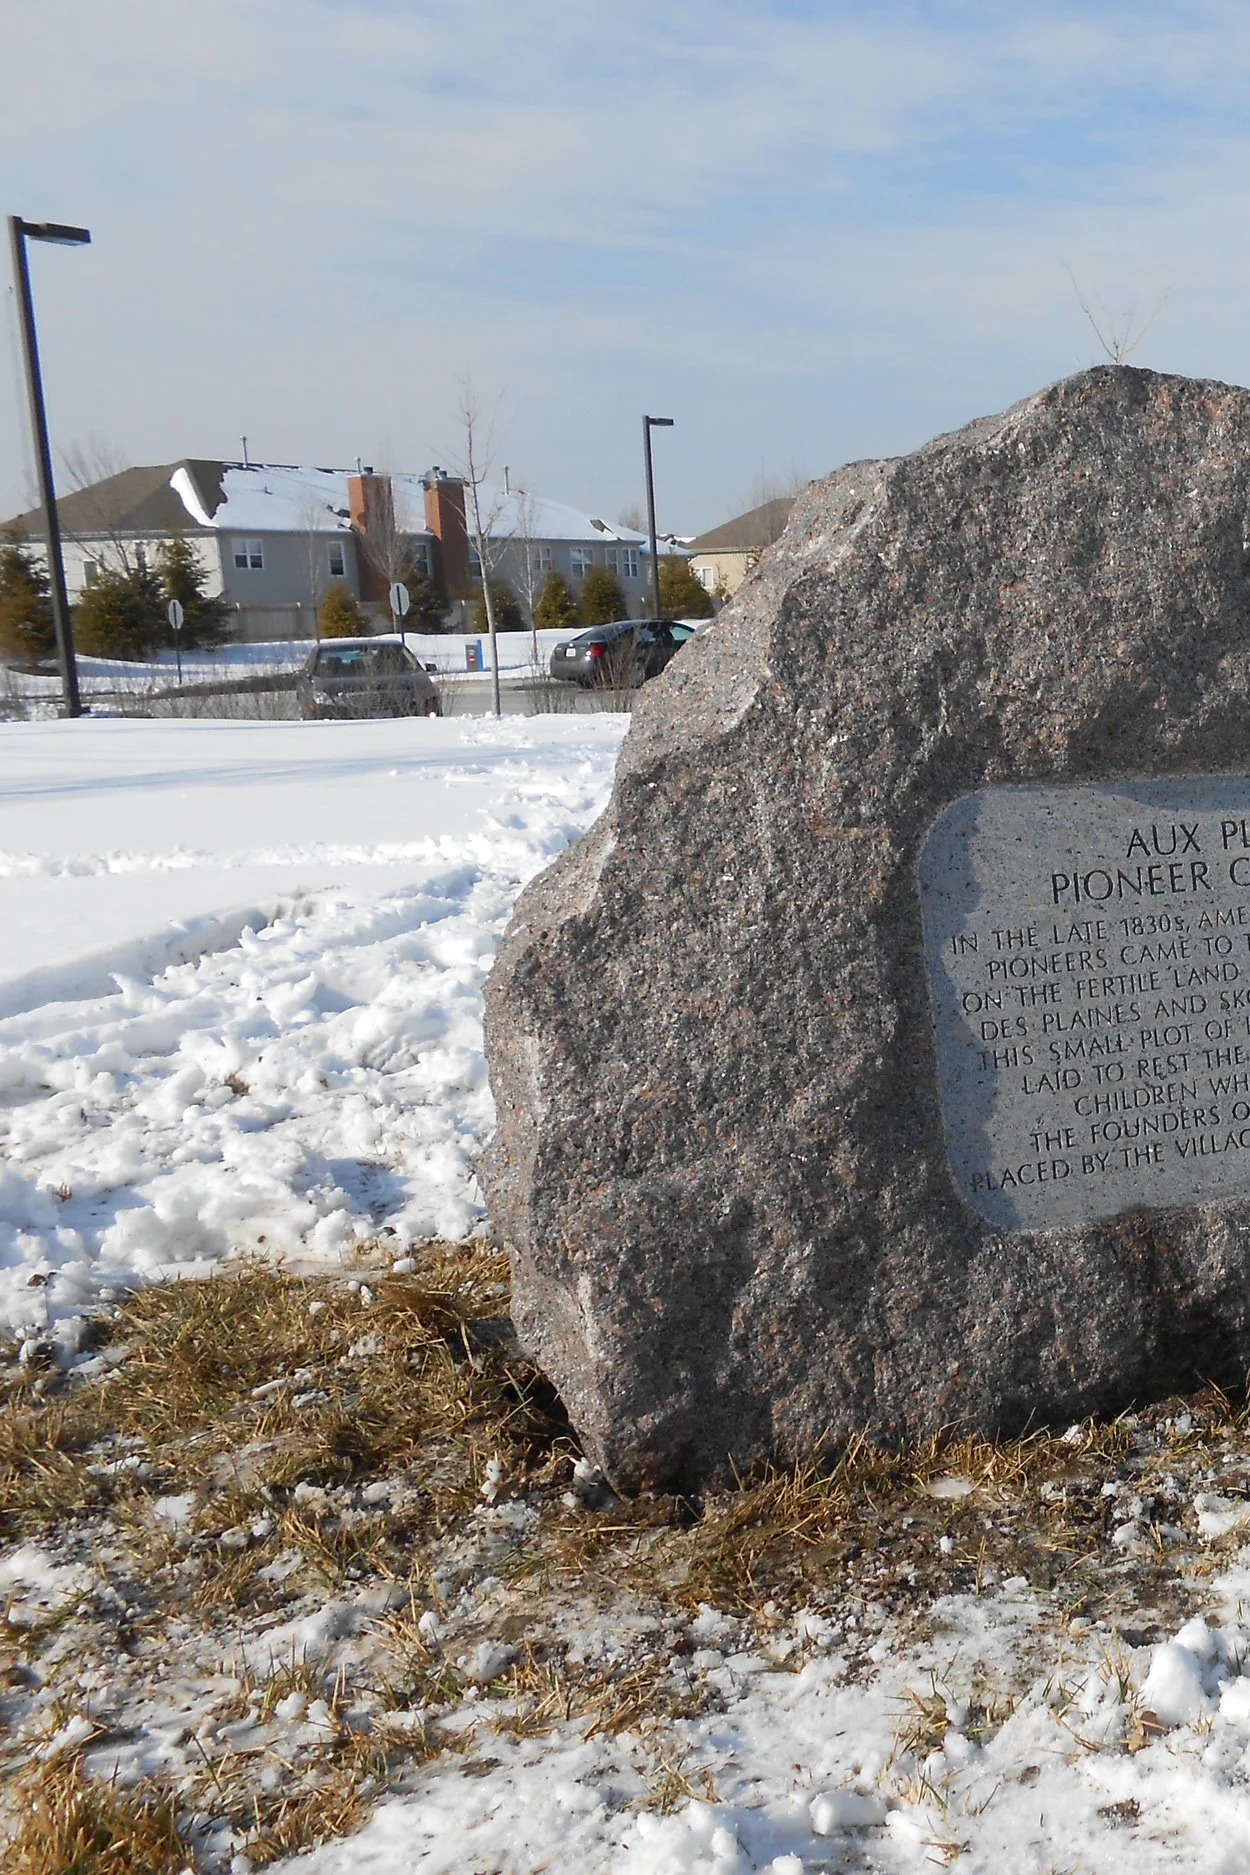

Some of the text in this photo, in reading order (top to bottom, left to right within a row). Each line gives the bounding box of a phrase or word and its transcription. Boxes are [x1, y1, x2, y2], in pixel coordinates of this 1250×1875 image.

[1126, 823, 1201, 858] AUX
[1051, 861, 1213, 904] PIONEER
[951, 932, 978, 955] IN
[991, 927, 1039, 950] THE
[1052, 920, 1108, 945] LATE
[986, 949, 1108, 981] PIONEERS
[1120, 939, 1191, 965] CAME
[1203, 935, 1232, 956] TO
[962, 991, 1002, 1013] ON
[1016, 982, 1063, 1007] THE
[1076, 971, 1161, 1000] FERTILE
[1173, 963, 1239, 989] LAND
[981, 1016, 1028, 1041] DES
[1042, 1001, 1142, 1033] PLAINES
[1154, 994, 1208, 1019] AND
[977, 1045, 1034, 1071] THIS
[1049, 1034, 1129, 1062] SMALL
[1140, 1023, 1193, 1049] PLOT
[1204, 1018, 1234, 1041] OF
[1022, 1068, 1082, 1095] LAID
[1092, 1062, 1124, 1085] TO
[1137, 1053, 1191, 1079] REST
[1202, 1045, 1244, 1069] THE
[1074, 1081, 1197, 1116] CHILDREN
[1029, 1128, 1077, 1153] THE
[1090, 1105, 1221, 1144] FOUNDERS
[971, 1159, 1071, 1192] PLACED
[1082, 1152, 1110, 1174] BY
[1122, 1142, 1165, 1168] THE
